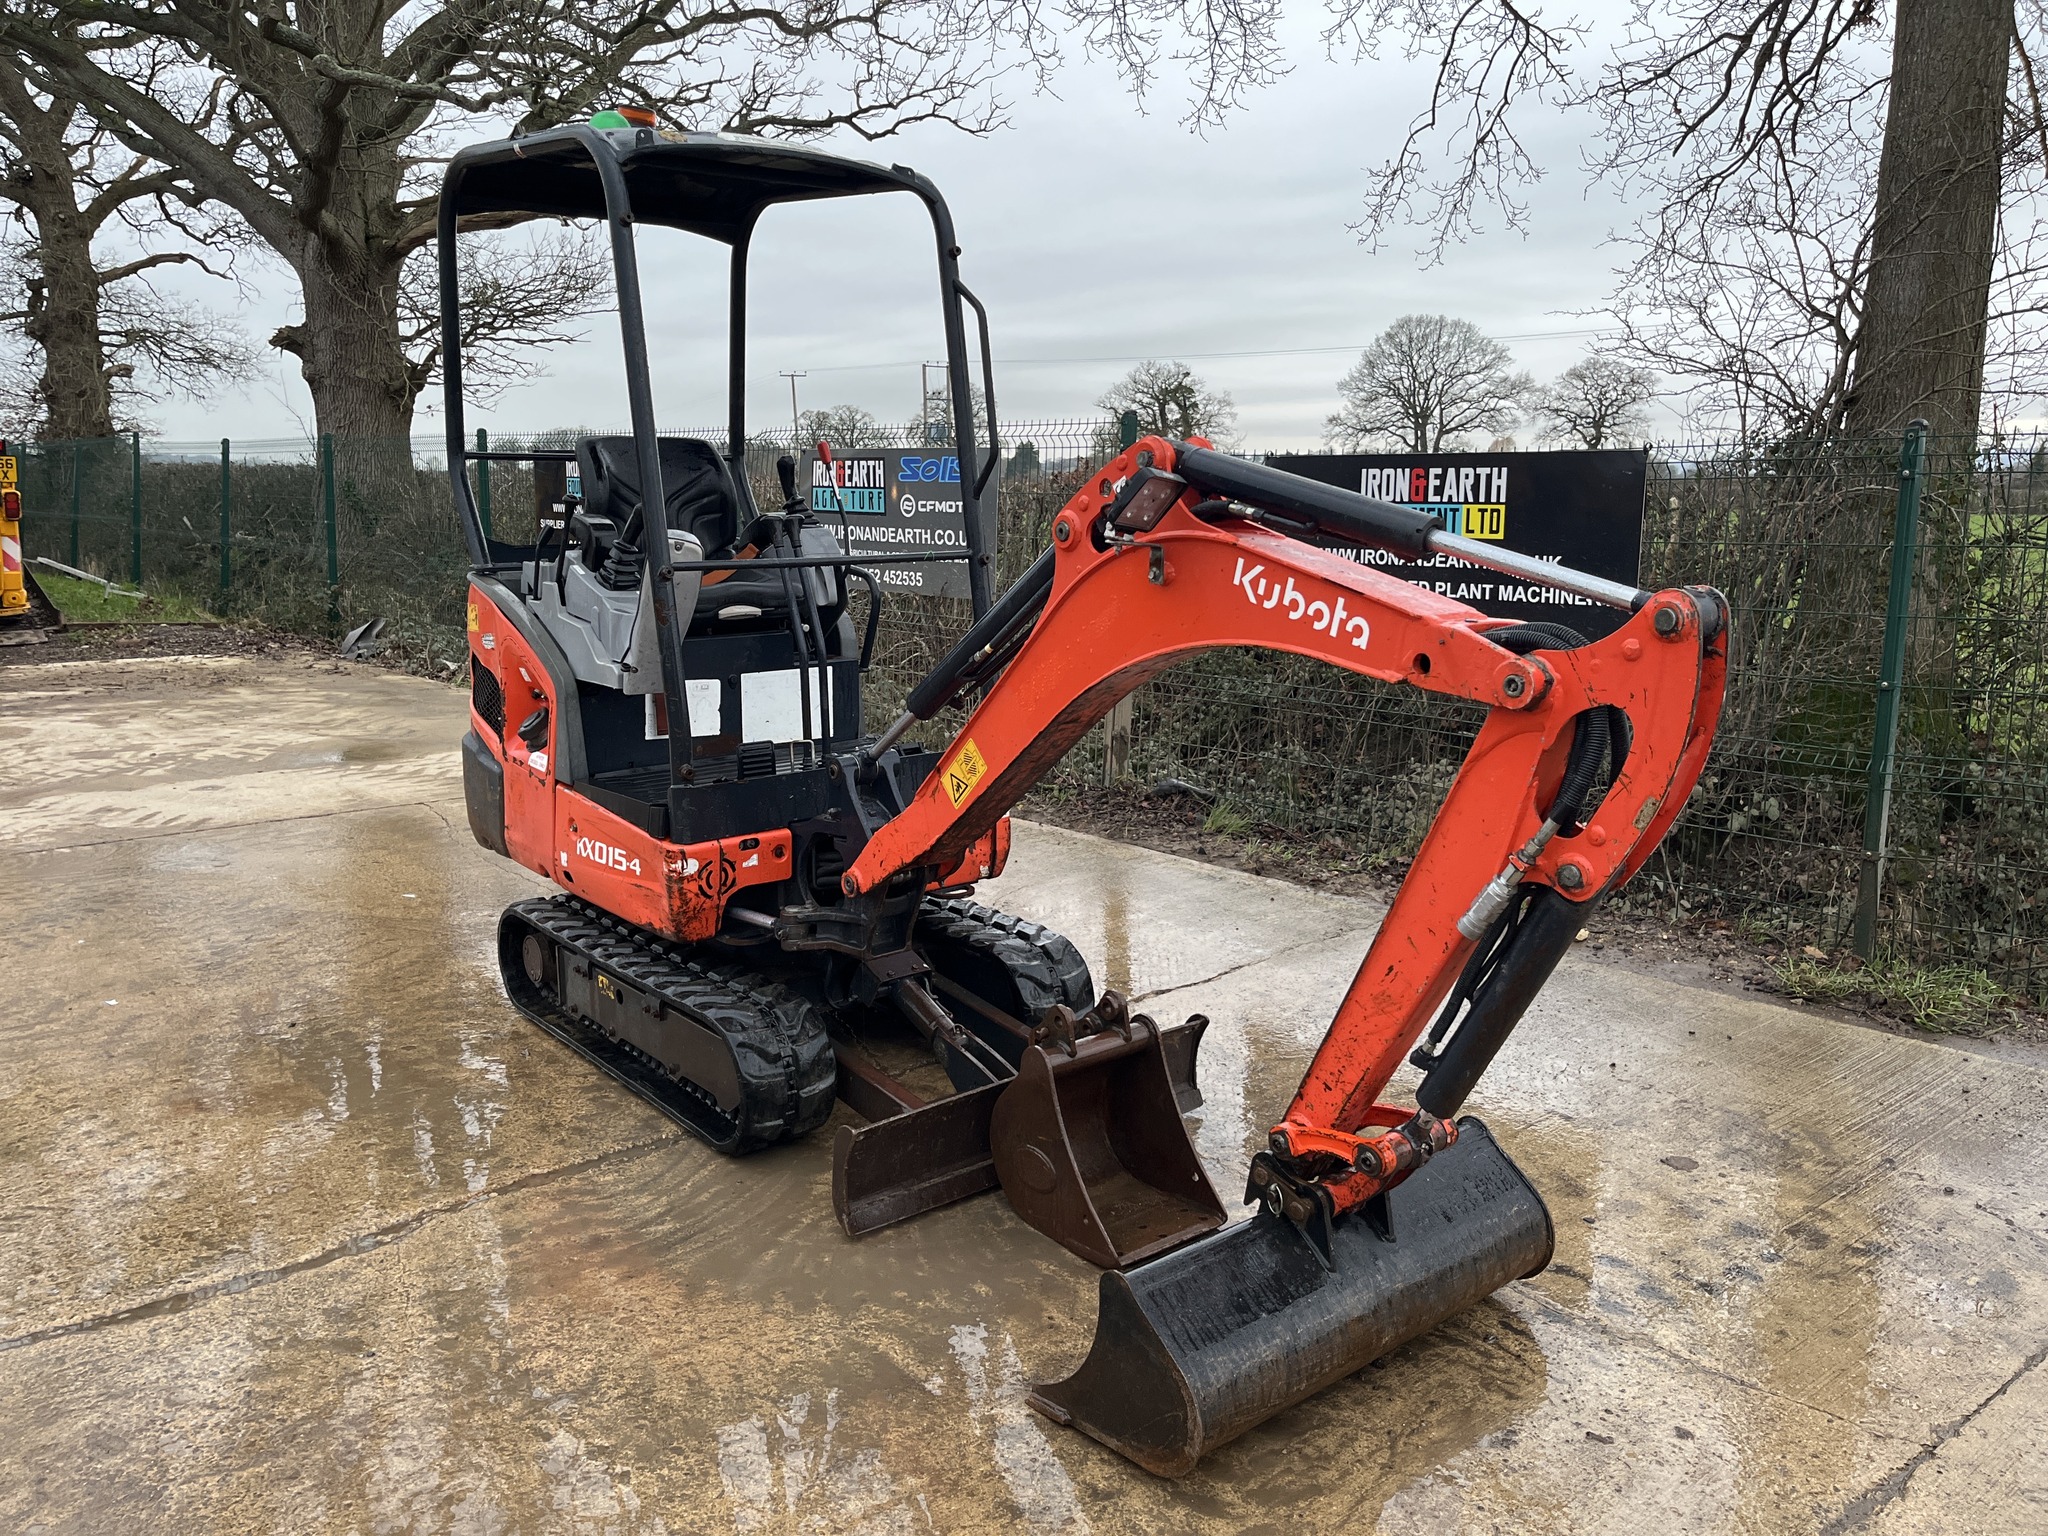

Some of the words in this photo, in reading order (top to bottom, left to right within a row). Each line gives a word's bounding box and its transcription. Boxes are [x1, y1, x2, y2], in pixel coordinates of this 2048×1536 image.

[1360, 467, 1508, 502] IRON&EARTH
[851, 491, 882, 511] TURF
[917, 501, 963, 513] CFMOT
[1465, 508, 1501, 535] LTD
[883, 569, 923, 586] 452535
[1435, 581, 1494, 601] PLANT
[1233, 557, 1371, 650] Kubota
